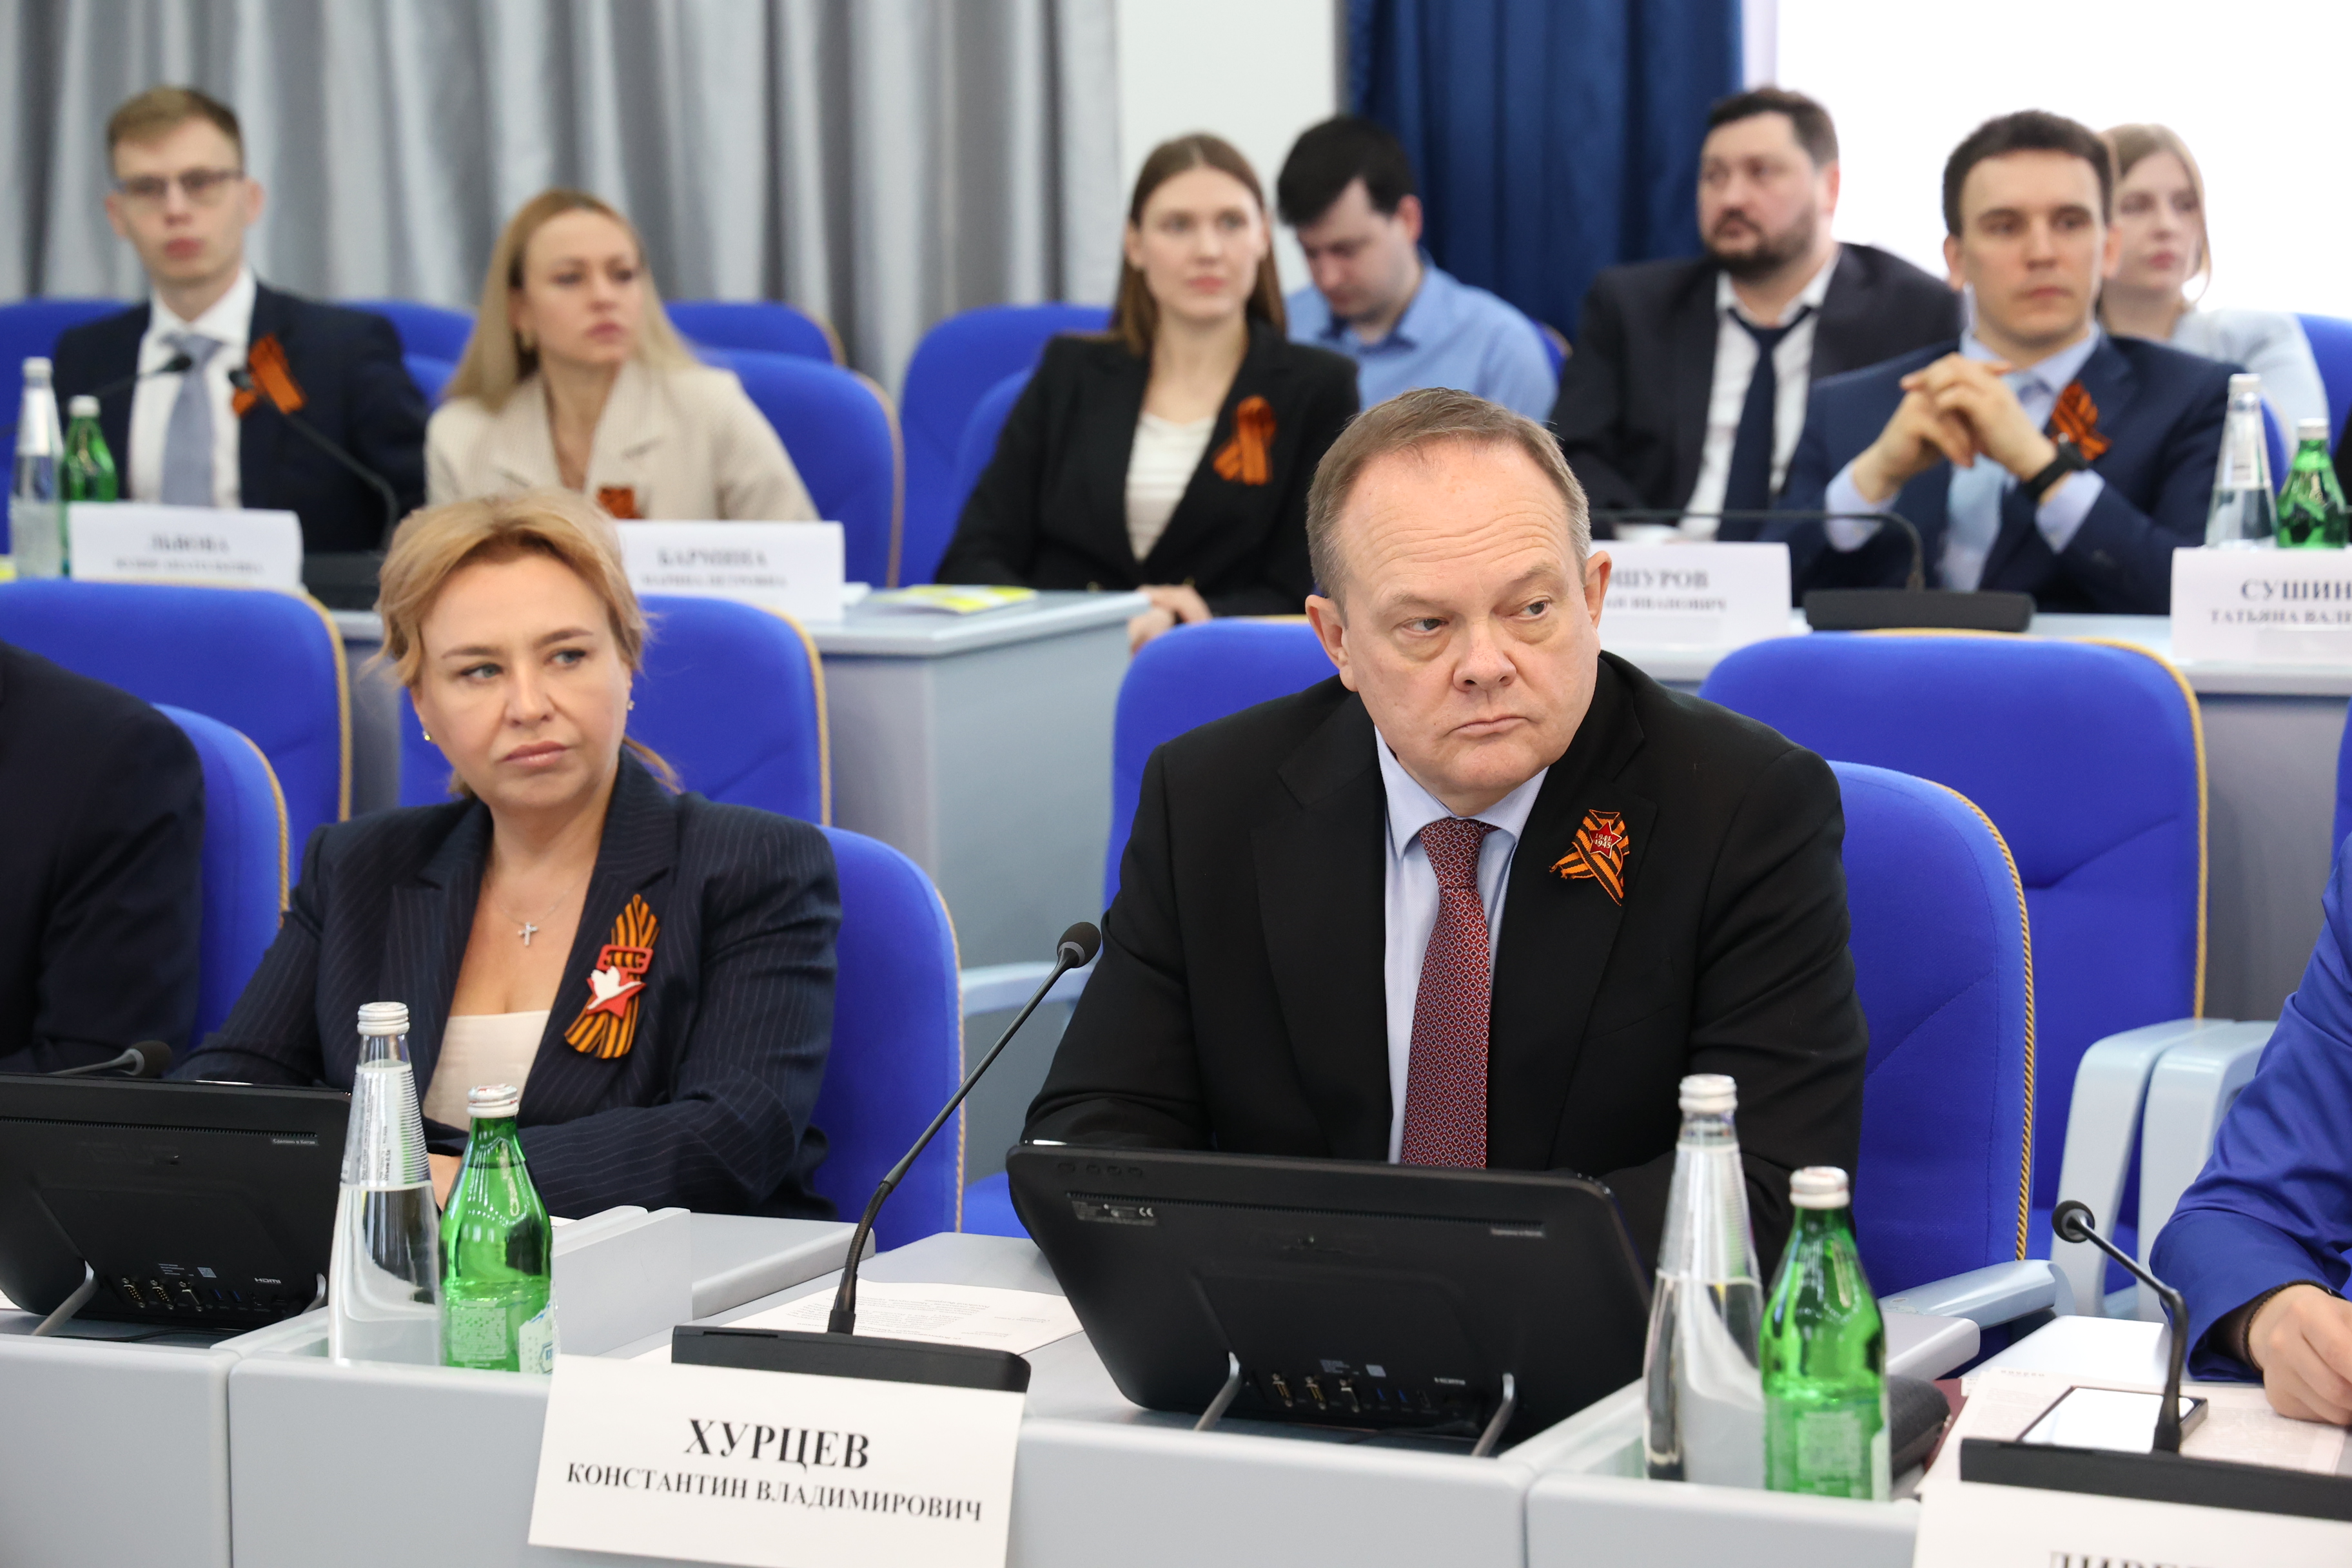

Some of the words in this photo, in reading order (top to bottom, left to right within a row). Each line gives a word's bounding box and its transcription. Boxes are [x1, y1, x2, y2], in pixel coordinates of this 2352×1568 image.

[2211, 609, 2299, 623] ТАТЬЯНА
[684, 1418, 869, 1473] ХУРЦЕВ
[567, 1462, 747, 1500] КОНСТАНТИН
[756, 1479, 981, 1522] ВЛАДИМИРОВИЧ
